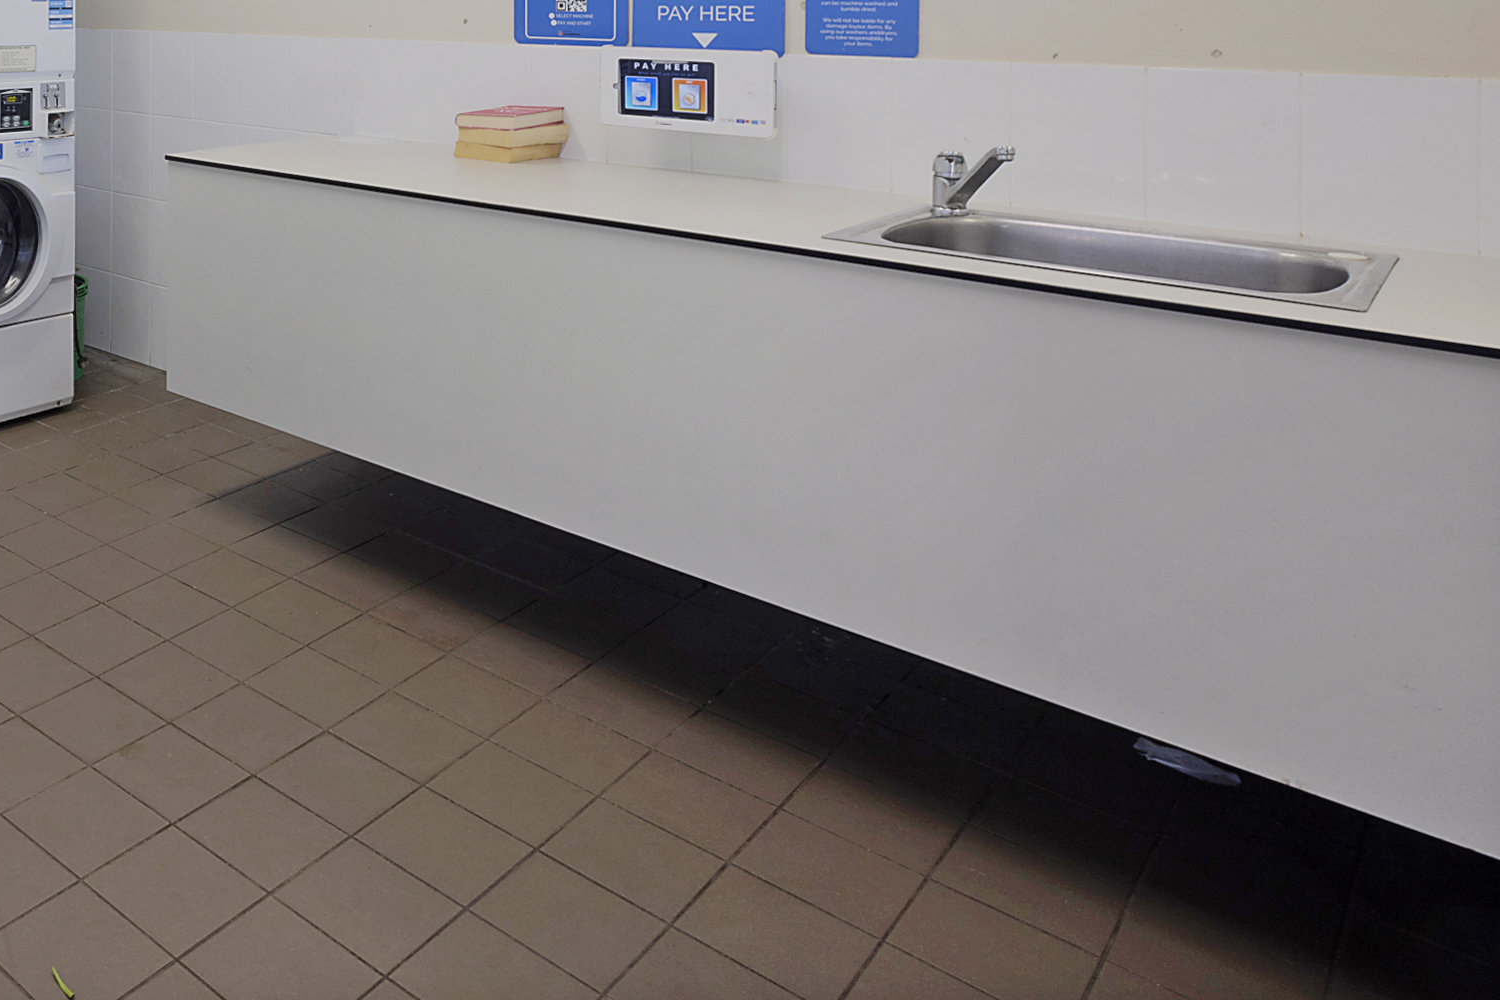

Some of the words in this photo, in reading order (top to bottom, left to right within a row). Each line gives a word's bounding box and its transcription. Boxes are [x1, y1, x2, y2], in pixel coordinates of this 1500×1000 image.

[657, 5, 694, 21] PAY
[700, 5, 755, 22] HERE
[634, 61, 657, 70] PAY
[664, 63, 699, 72] HERE
